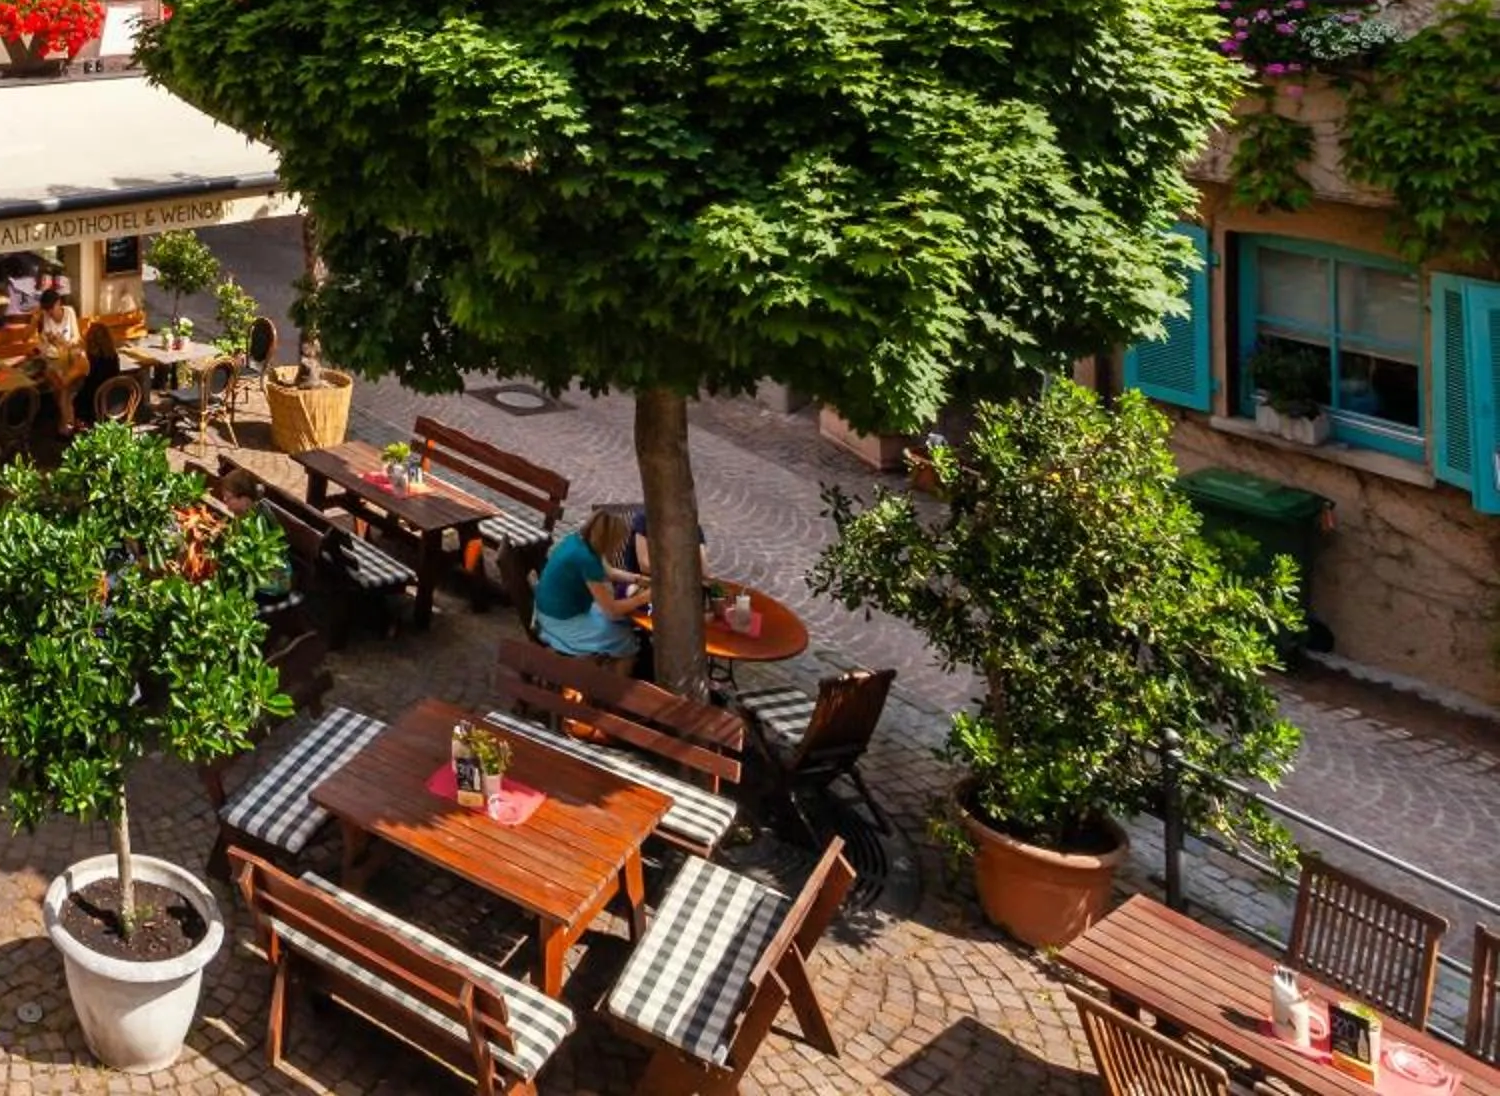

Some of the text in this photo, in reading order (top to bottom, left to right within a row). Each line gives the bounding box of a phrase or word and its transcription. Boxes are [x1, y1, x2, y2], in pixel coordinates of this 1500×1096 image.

[1, 200, 236, 247] ALTSTADTHOTEL & WEINBAR
